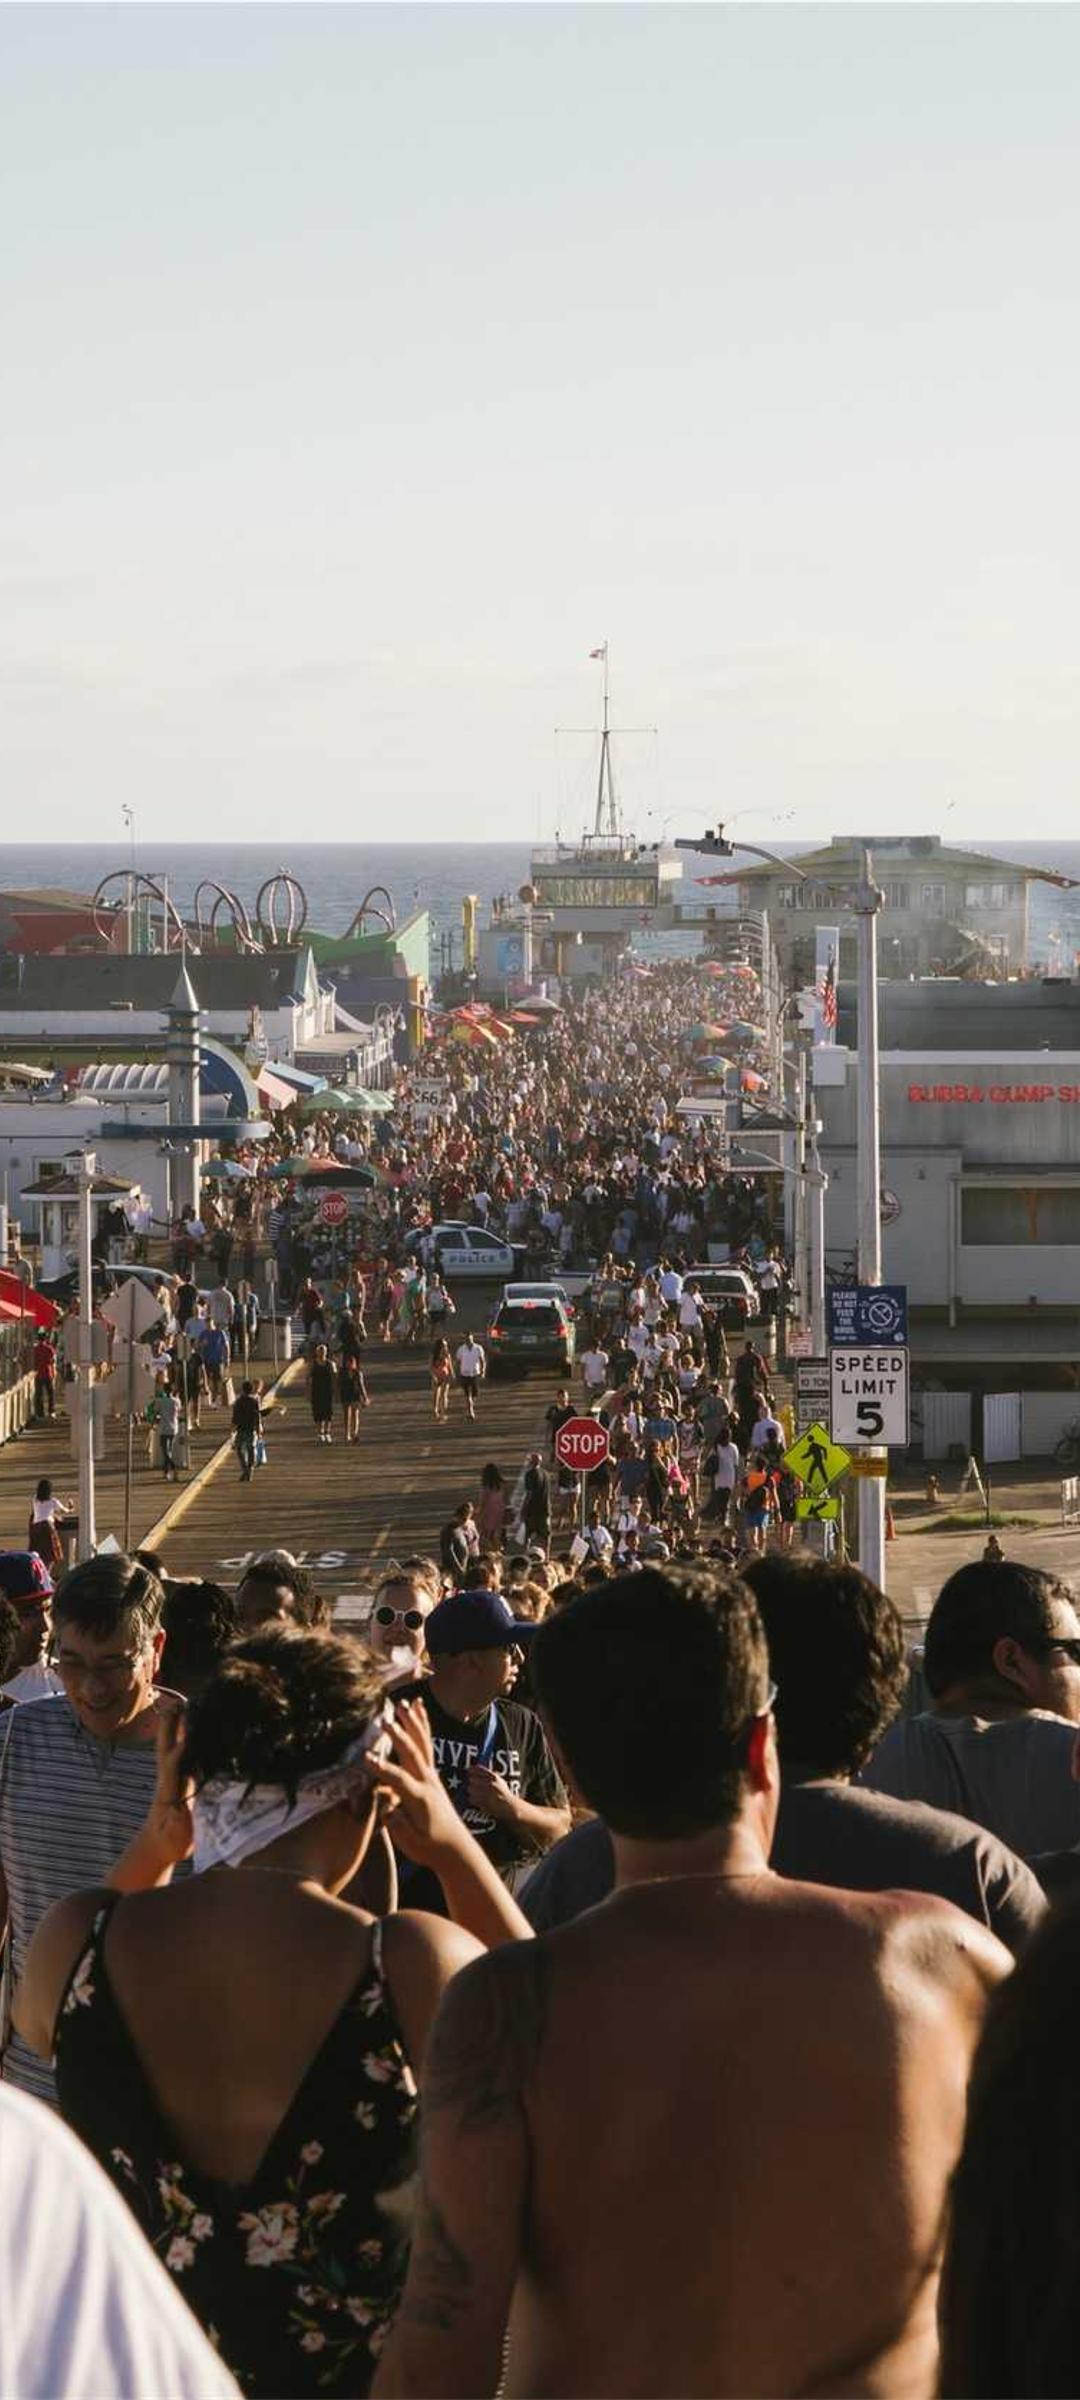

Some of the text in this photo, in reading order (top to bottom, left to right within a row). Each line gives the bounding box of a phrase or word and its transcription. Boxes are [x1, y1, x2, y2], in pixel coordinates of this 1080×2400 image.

[908, 1083, 984, 1103] BUBBA
[989, 1083, 1055, 1103] GUMP
[323, 1202, 345, 1216] STOP
[449, 1254, 495, 1263] POLICE
[832, 1291, 857, 1300] PLEASE
[832, 1300, 857, 1308] DO NOT
[836, 1308, 854, 1317] FEED
[839, 1317, 852, 1325] THE
[835, 1357, 903, 1372] SPEED
[841, 1380, 897, 1394] LIMIT
[856, 1401, 884, 1437] 5
[560, 1434, 605, 1454] STOP
